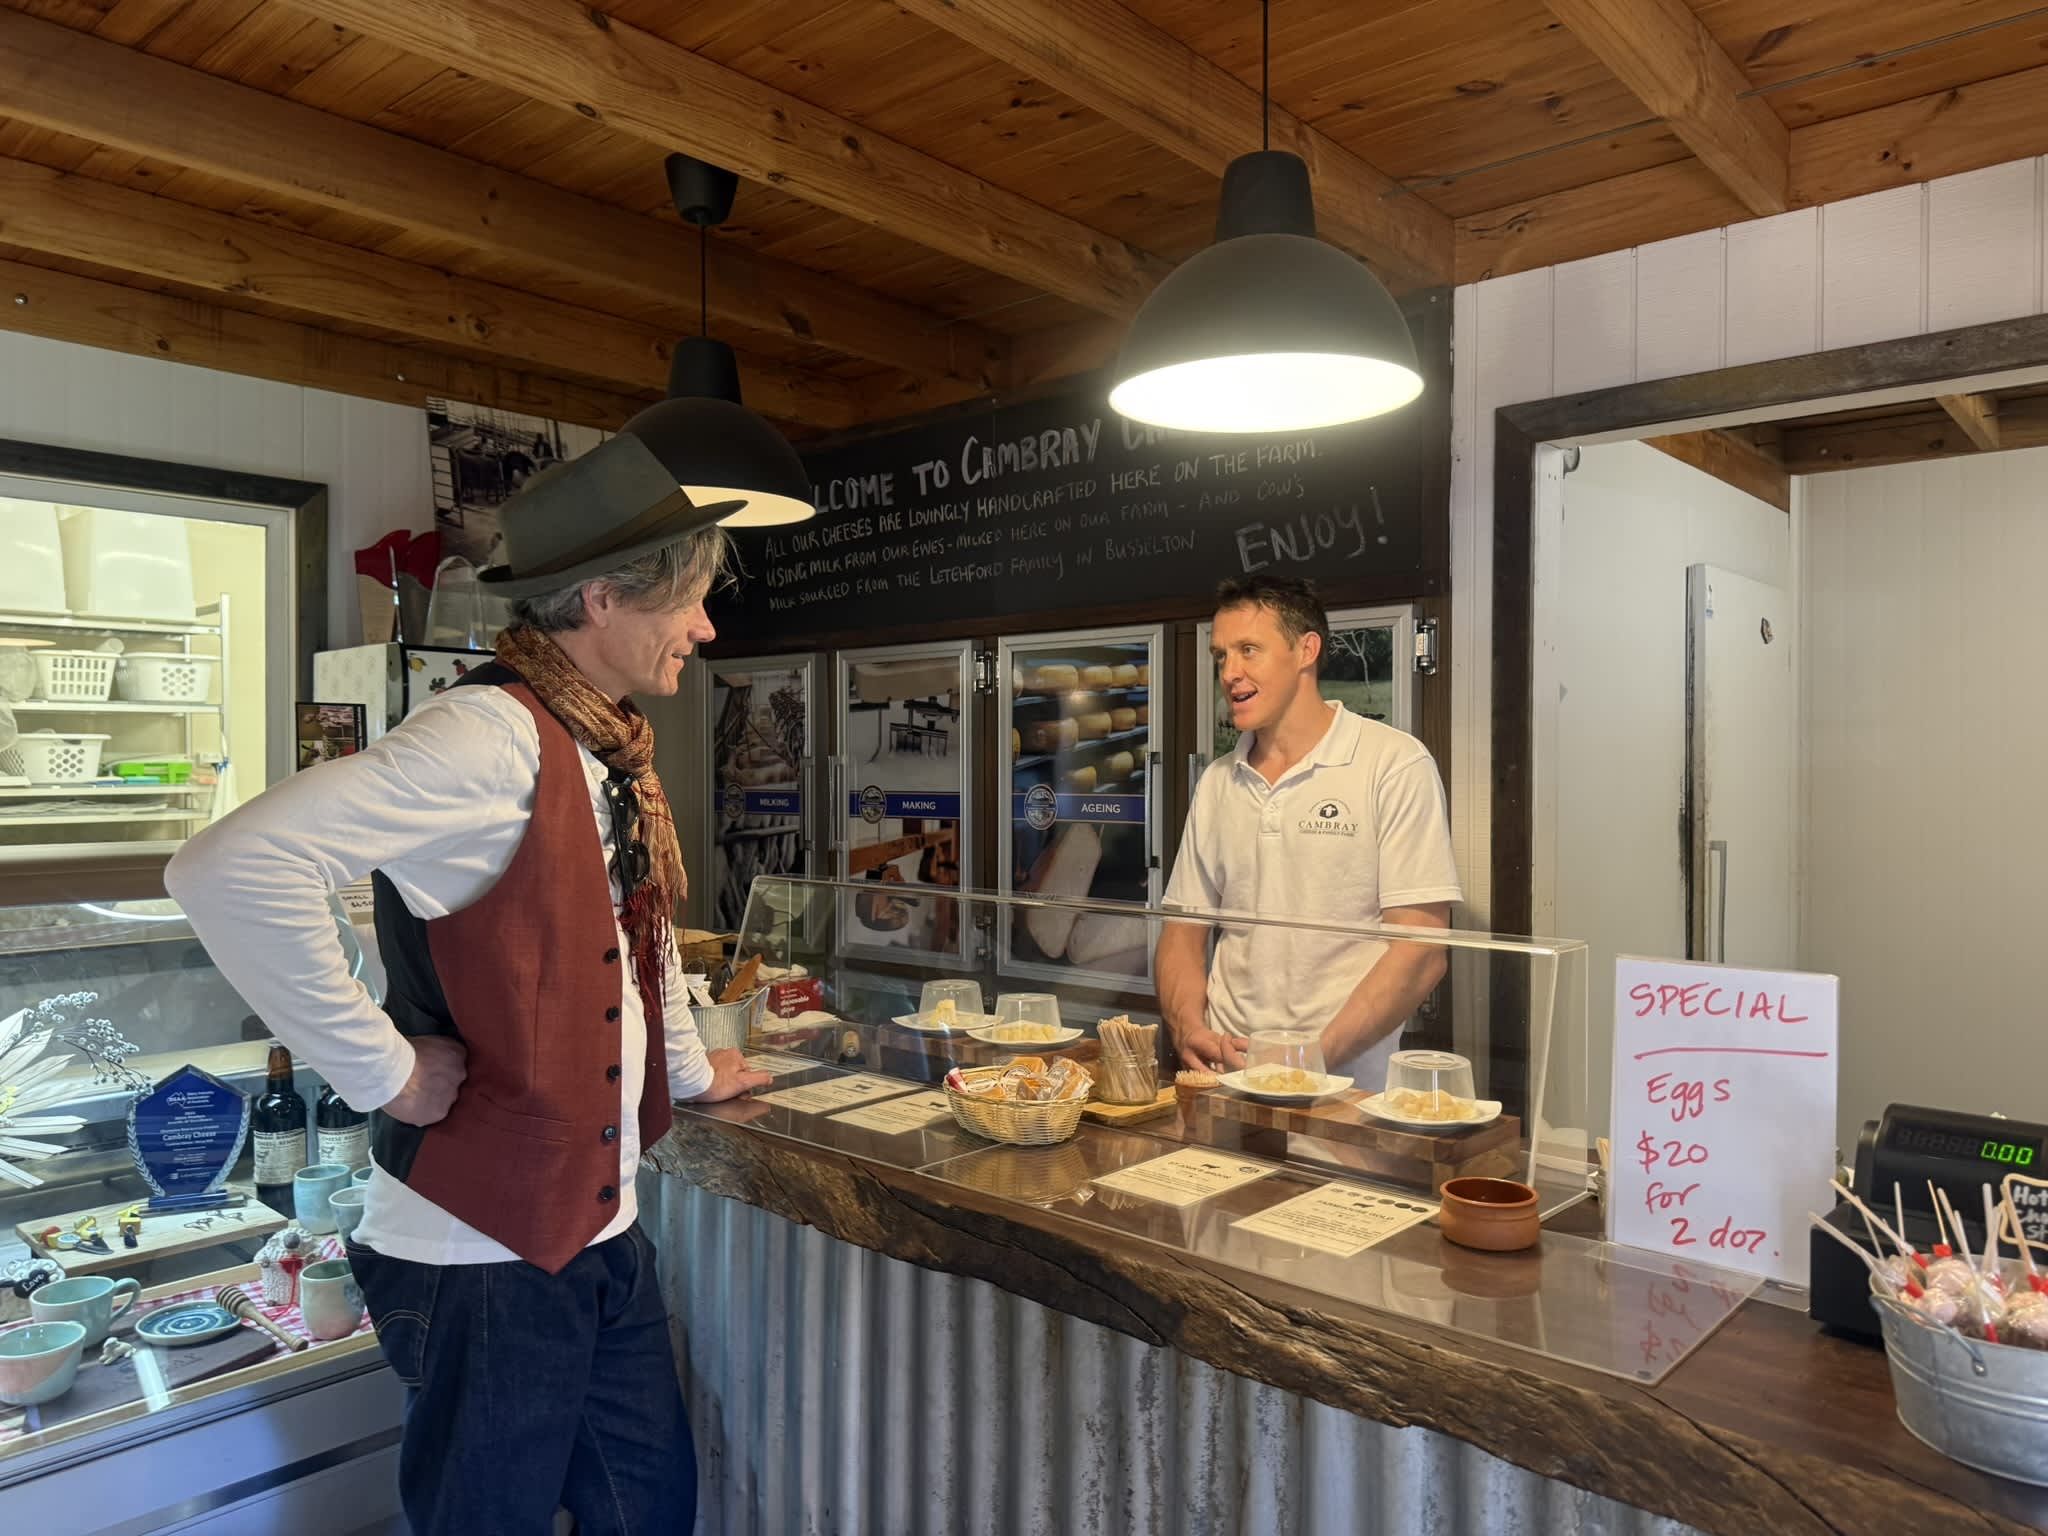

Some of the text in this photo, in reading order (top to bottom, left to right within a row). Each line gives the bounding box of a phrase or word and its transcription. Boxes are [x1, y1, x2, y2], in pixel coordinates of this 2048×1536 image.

[811, 472, 895, 514] LCOME
[912, 459, 950, 496] TO
[962, 419, 1101, 485] CAMBRAY
[765, 536, 787, 561] ALL
[792, 529, 820, 553] OUR
[822, 517, 873, 548] CHEESES
[879, 511, 902, 532] ARE
[909, 501, 969, 528] LOVINGLY
[977, 480, 1097, 518] HANDCRAFTED
[1111, 465, 1161, 493] HERE
[1175, 456, 1199, 482] ON
[1209, 451, 1248, 475] THE
[766, 559, 808, 589] USING
[809, 557, 842, 577] MILK
[845, 551, 877, 571] FROM
[882, 545, 909, 561] OUR
[912, 538, 945, 558] EWES
[1011, 522, 1047, 541] HERE
[1055, 515, 1072, 531] ON
[1120, 502, 1169, 521] FARM
[1199, 489, 1241, 512] AND
[769, 530, 1197, 613] MILK SOURCED FROM THE LETCHFORD FAMILY IN BUSSELTON
[760, 798, 789, 807] MILKING
[902, 801, 936, 810] MAKING
[1081, 804, 1121, 813] AGEING
[1298, 820, 1358, 831] CAMBRAY
[1629, 982, 1808, 1023] SPECIAL
[1647, 1073, 1731, 1122] Eggs
[1636, 1131, 1709, 1173] $20
[1981, 1141, 2033, 1165] 0.00
[1645, 1182, 1701, 1213] for
[2013, 1184, 2048, 1207] Hot
[1671, 1218, 1696, 1246] 2
[22, 1274, 45, 1292] Love
